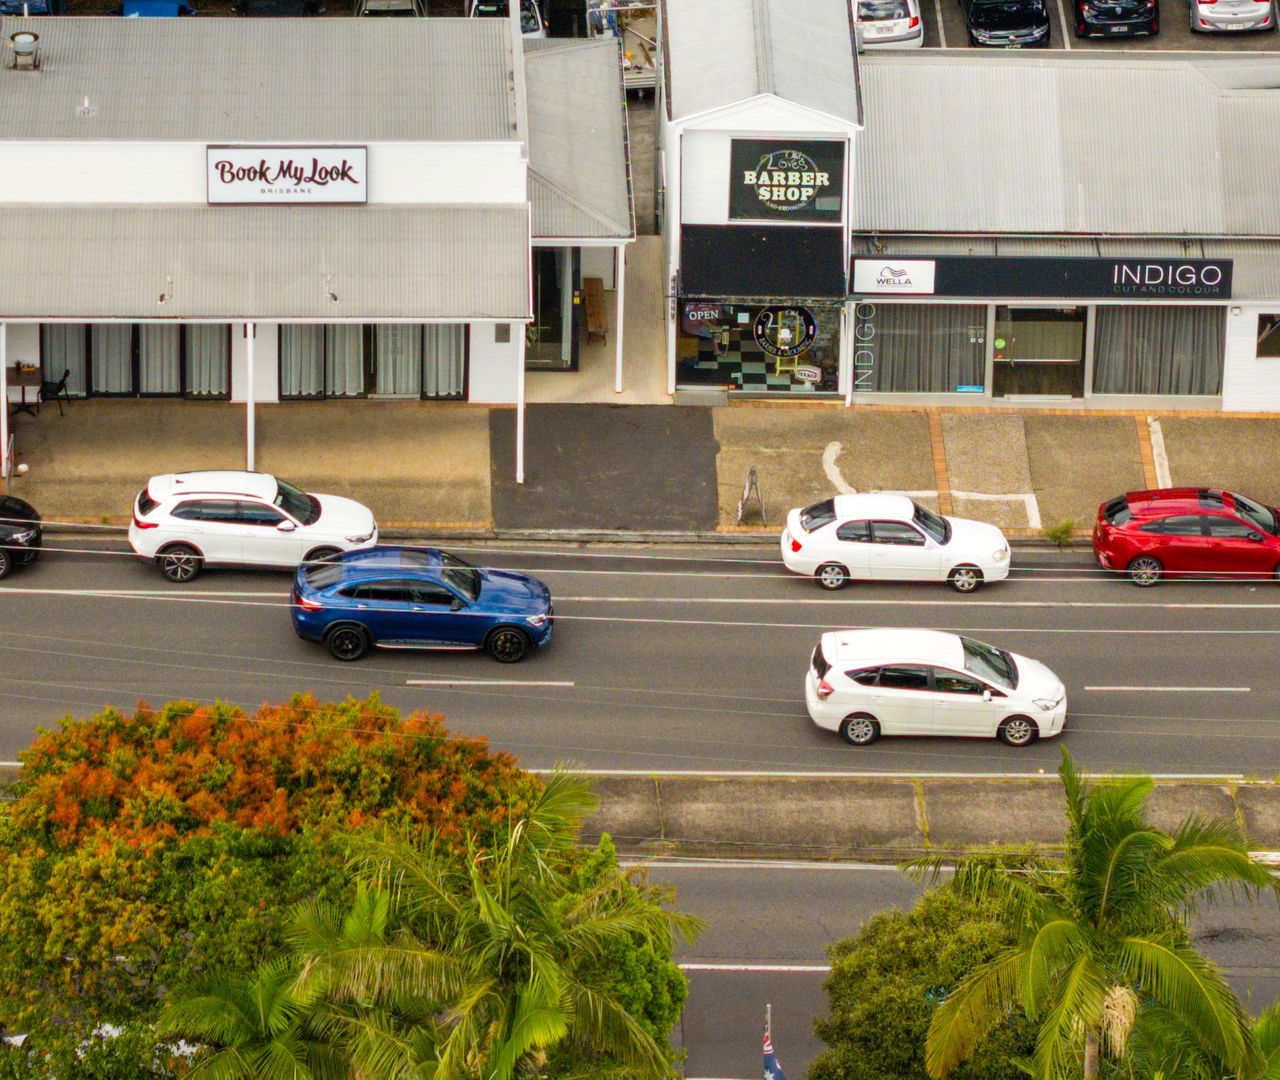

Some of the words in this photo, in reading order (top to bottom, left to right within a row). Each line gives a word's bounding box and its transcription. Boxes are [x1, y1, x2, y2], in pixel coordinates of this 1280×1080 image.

[761, 154, 808, 171] Loves
[215, 159, 274, 185] Book
[271, 159, 304, 186] My
[303, 158, 360, 186] Look
[743, 170, 830, 186] BARBER
[758, 186, 814, 201] SHOP
[1113, 265, 1222, 285] INDIGO
[1168, 286, 1220, 294] COLOUR
[689, 310, 719, 320] OPEN
[854, 303, 876, 391] INDIGO
